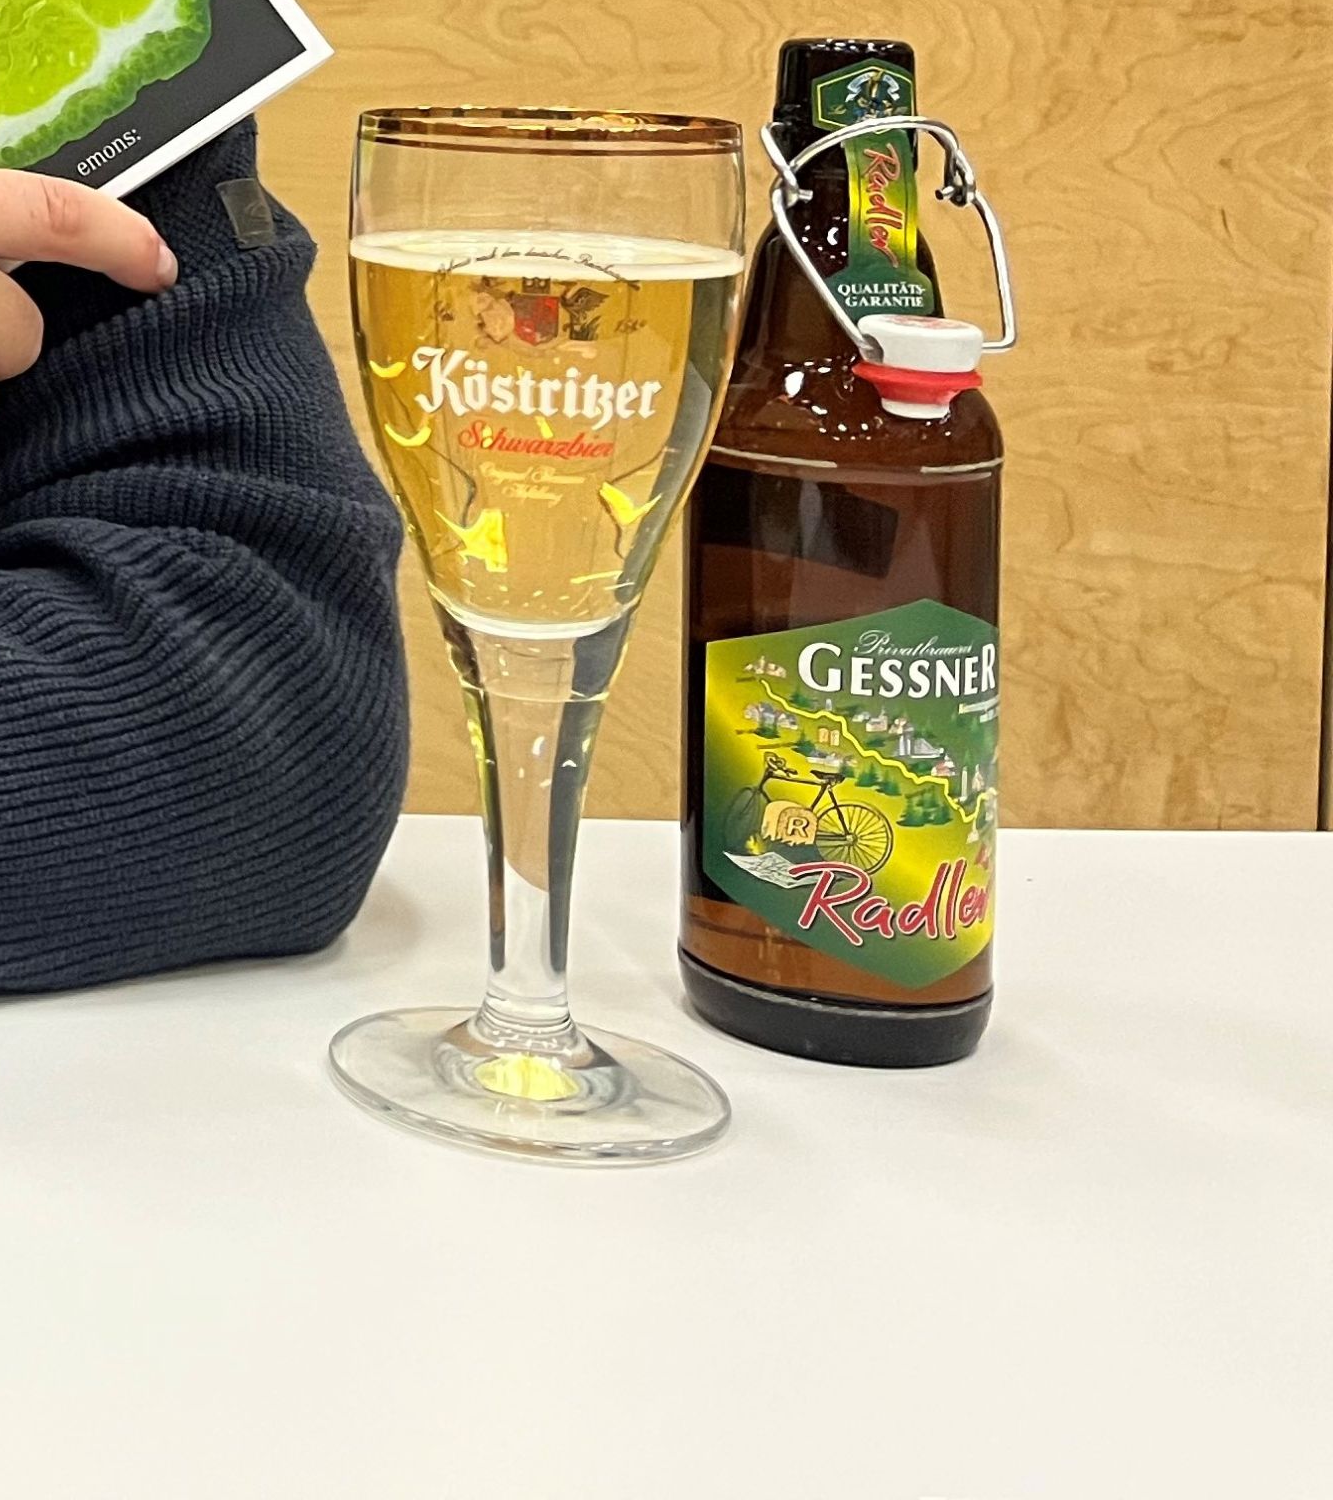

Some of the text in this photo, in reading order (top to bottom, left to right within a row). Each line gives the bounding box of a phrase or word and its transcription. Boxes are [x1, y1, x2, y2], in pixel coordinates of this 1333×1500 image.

[76, 127, 142, 178] emons:
[864, 143, 904, 268] Radler
[845, 296, 924, 307] GARANTIE
[411, 346, 662, 431] Köstritzer
[797, 642, 996, 698] GESSNER
[788, 815, 810, 838] R
[788, 859, 989, 947] Radler
